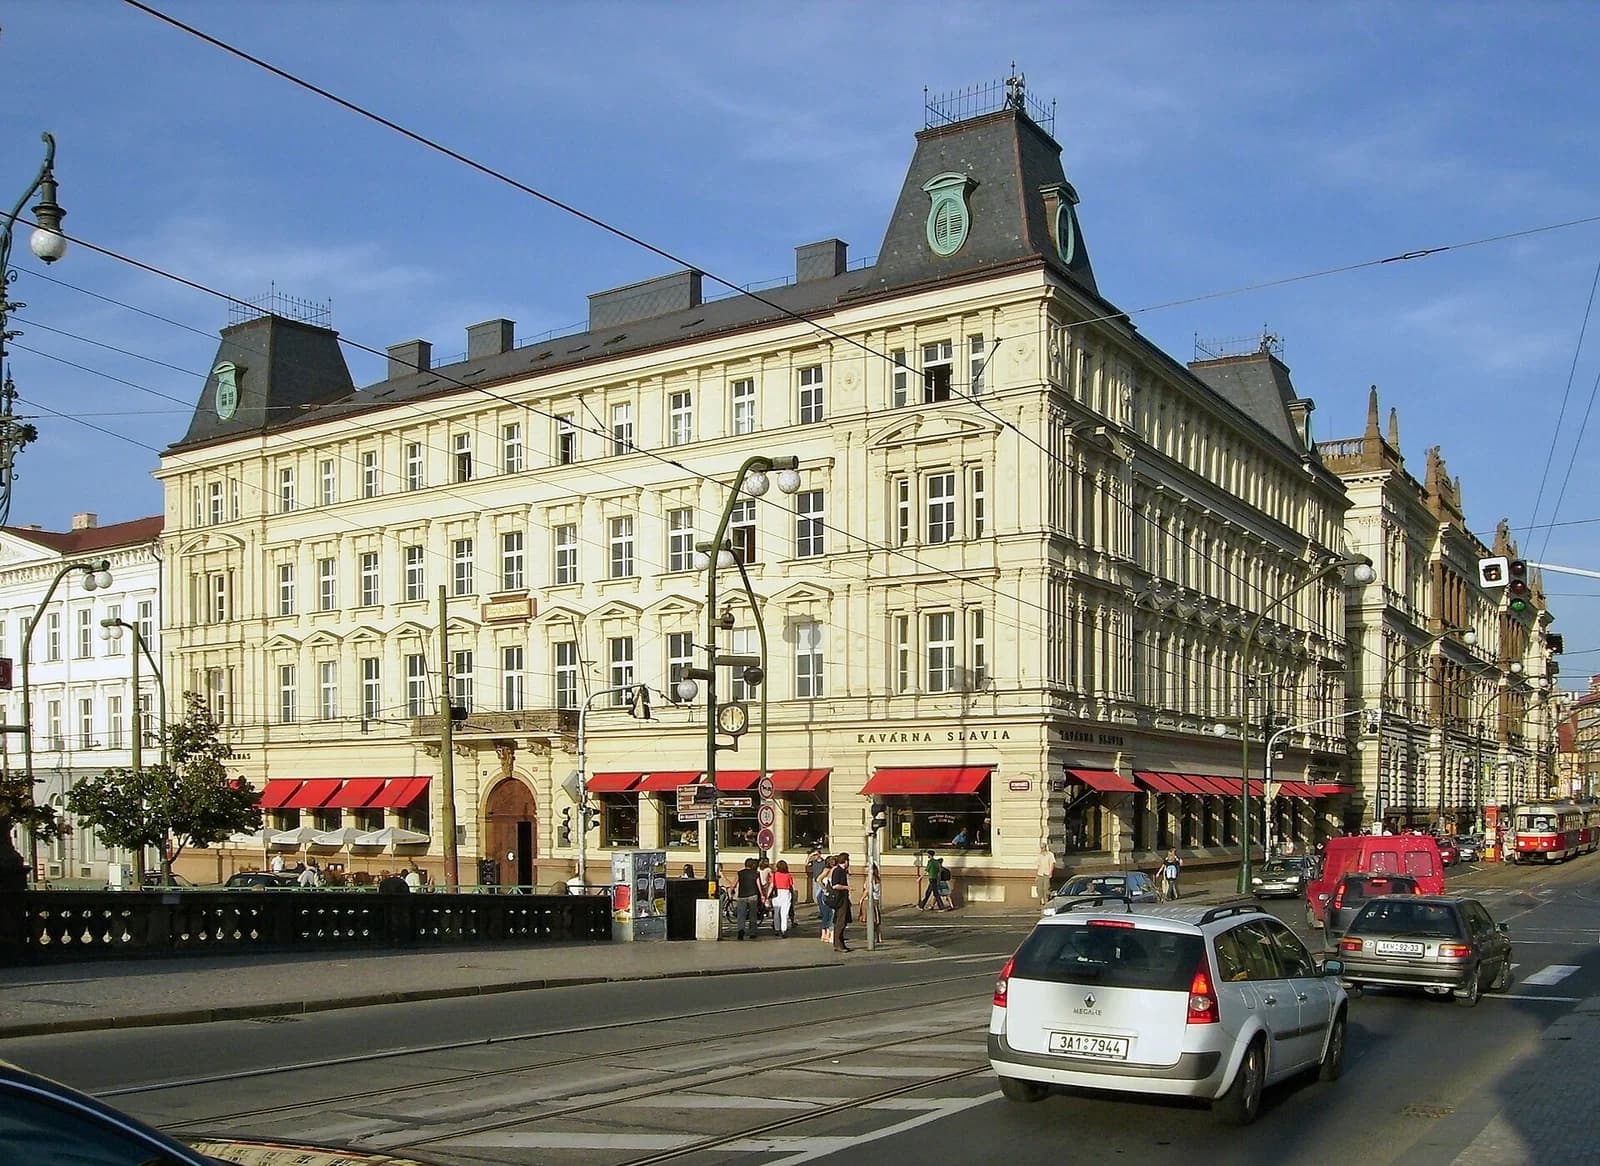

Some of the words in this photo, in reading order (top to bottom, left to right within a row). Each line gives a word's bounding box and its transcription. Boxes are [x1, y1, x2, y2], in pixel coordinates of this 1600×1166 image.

[857, 731, 932, 743] KAVÁRNA
[947, 730, 1010, 741] SLAVIA
[1060, 1036, 1081, 1050] 3A1
[1090, 1039, 1120, 1054] 7944
